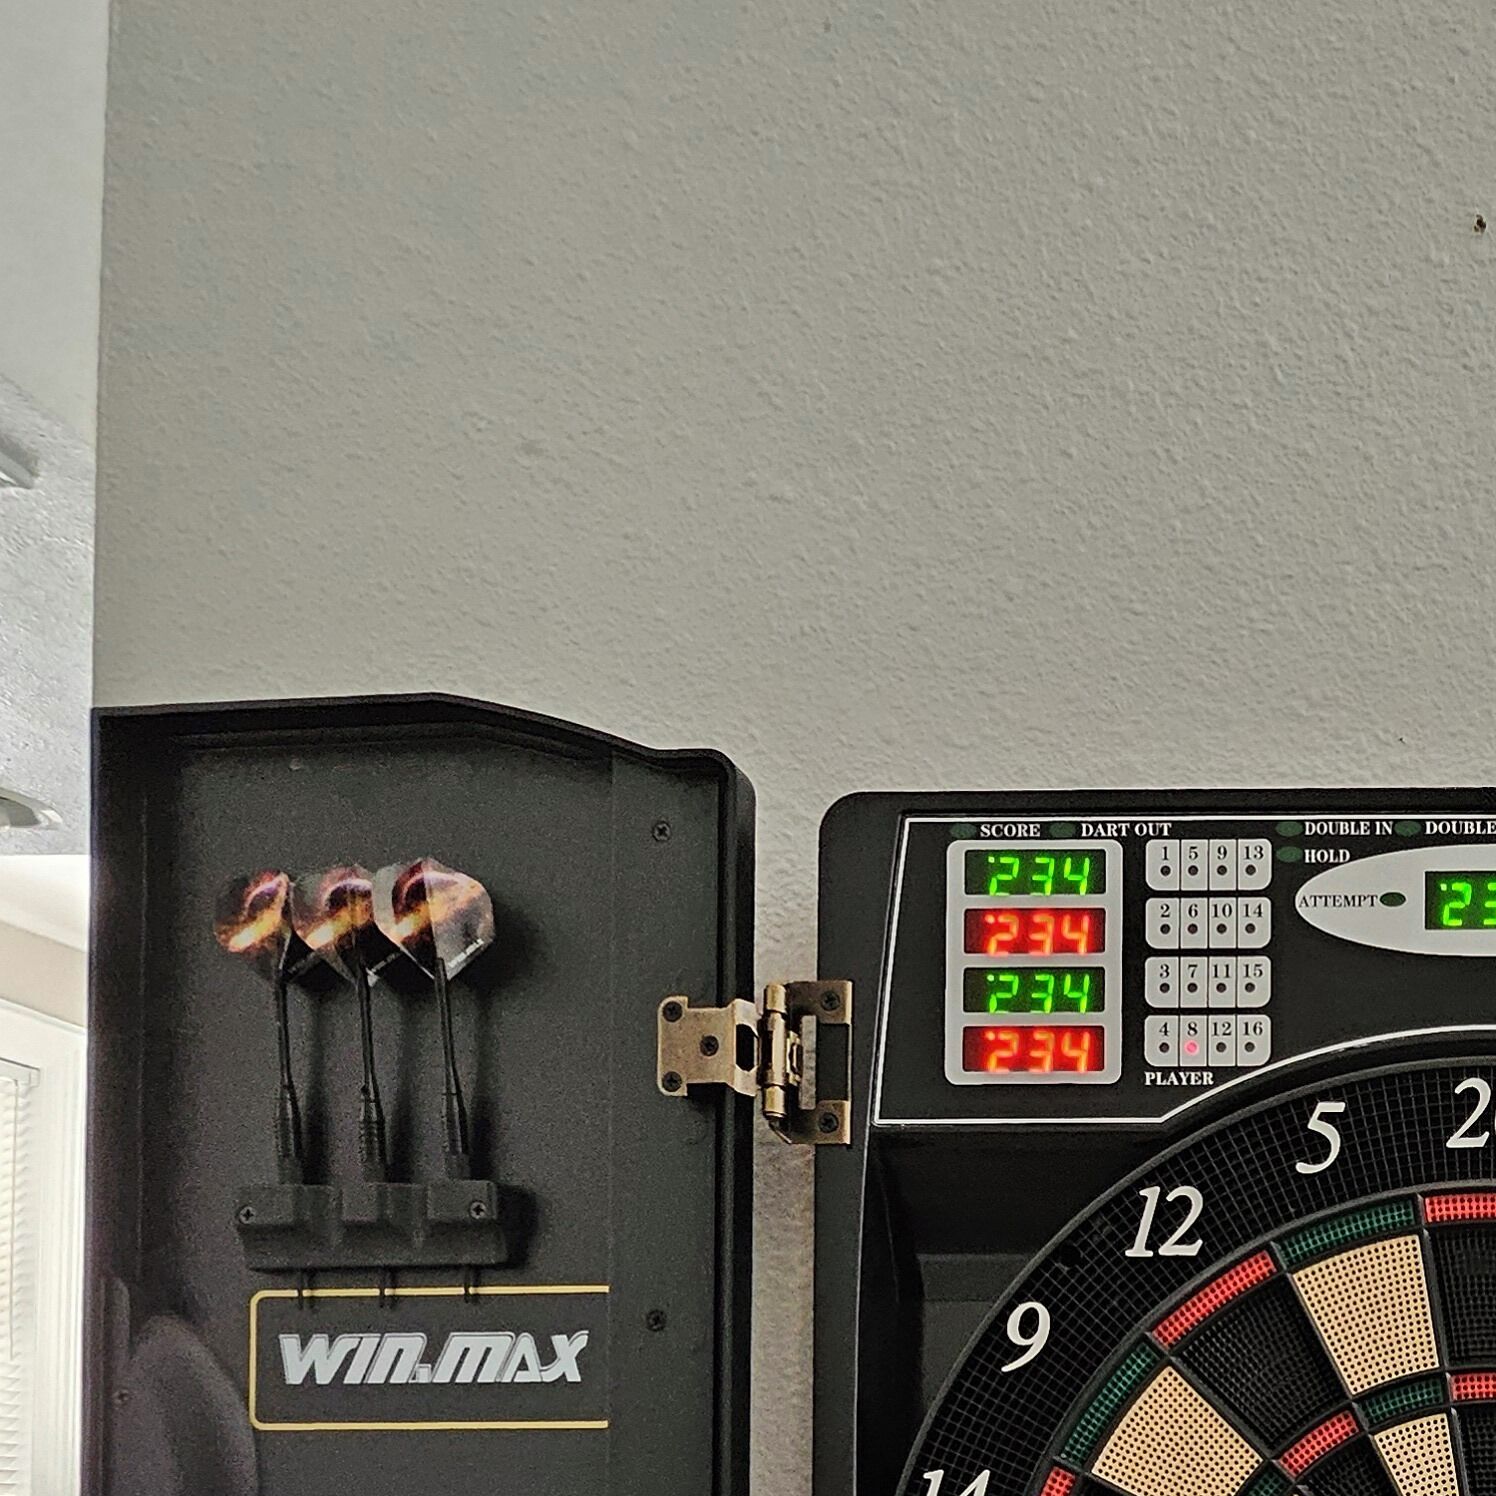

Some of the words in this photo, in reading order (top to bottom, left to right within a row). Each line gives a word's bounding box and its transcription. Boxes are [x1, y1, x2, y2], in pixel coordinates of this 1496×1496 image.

[981, 824, 1040, 837] SCORE
[1082, 823, 1129, 837] DART
[1135, 823, 1171, 836] OUT
[1304, 822, 1371, 835] DOUBLE
[1375, 822, 1392, 835] IN
[1425, 821, 1496, 834] DOUBLE
[1162, 847, 1169, 860] 1
[1189, 847, 1198, 859] 5
[1218, 846, 1227, 859] 9
[1245, 846, 1263, 859] 13
[1305, 850, 1350, 863] HOLD
[1299, 895, 1378, 907] ATTEMPT
[1161, 904, 1170, 917] 2
[1189, 904, 1198, 917] 6
[1214, 904, 1232, 917] 10
[1245, 904, 1262, 917] 14
[1160, 964, 1169, 977] 3
[1188, 965, 1197, 978] 7
[1214, 964, 1229, 978] 11
[1245, 964, 1262, 977] 15
[1159, 1023, 1169, 1036] 4
[1188, 1023, 1197, 1035] 8
[1214, 1022, 1231, 1036] 12
[1245, 1022, 1262, 1035] 16
[1145, 1072, 1213, 1085] PLAYER
[1296, 1102, 1345, 1173] 5
[1125, 1186, 1203, 1257] 12
[1001, 1302, 1050, 1372] 9
